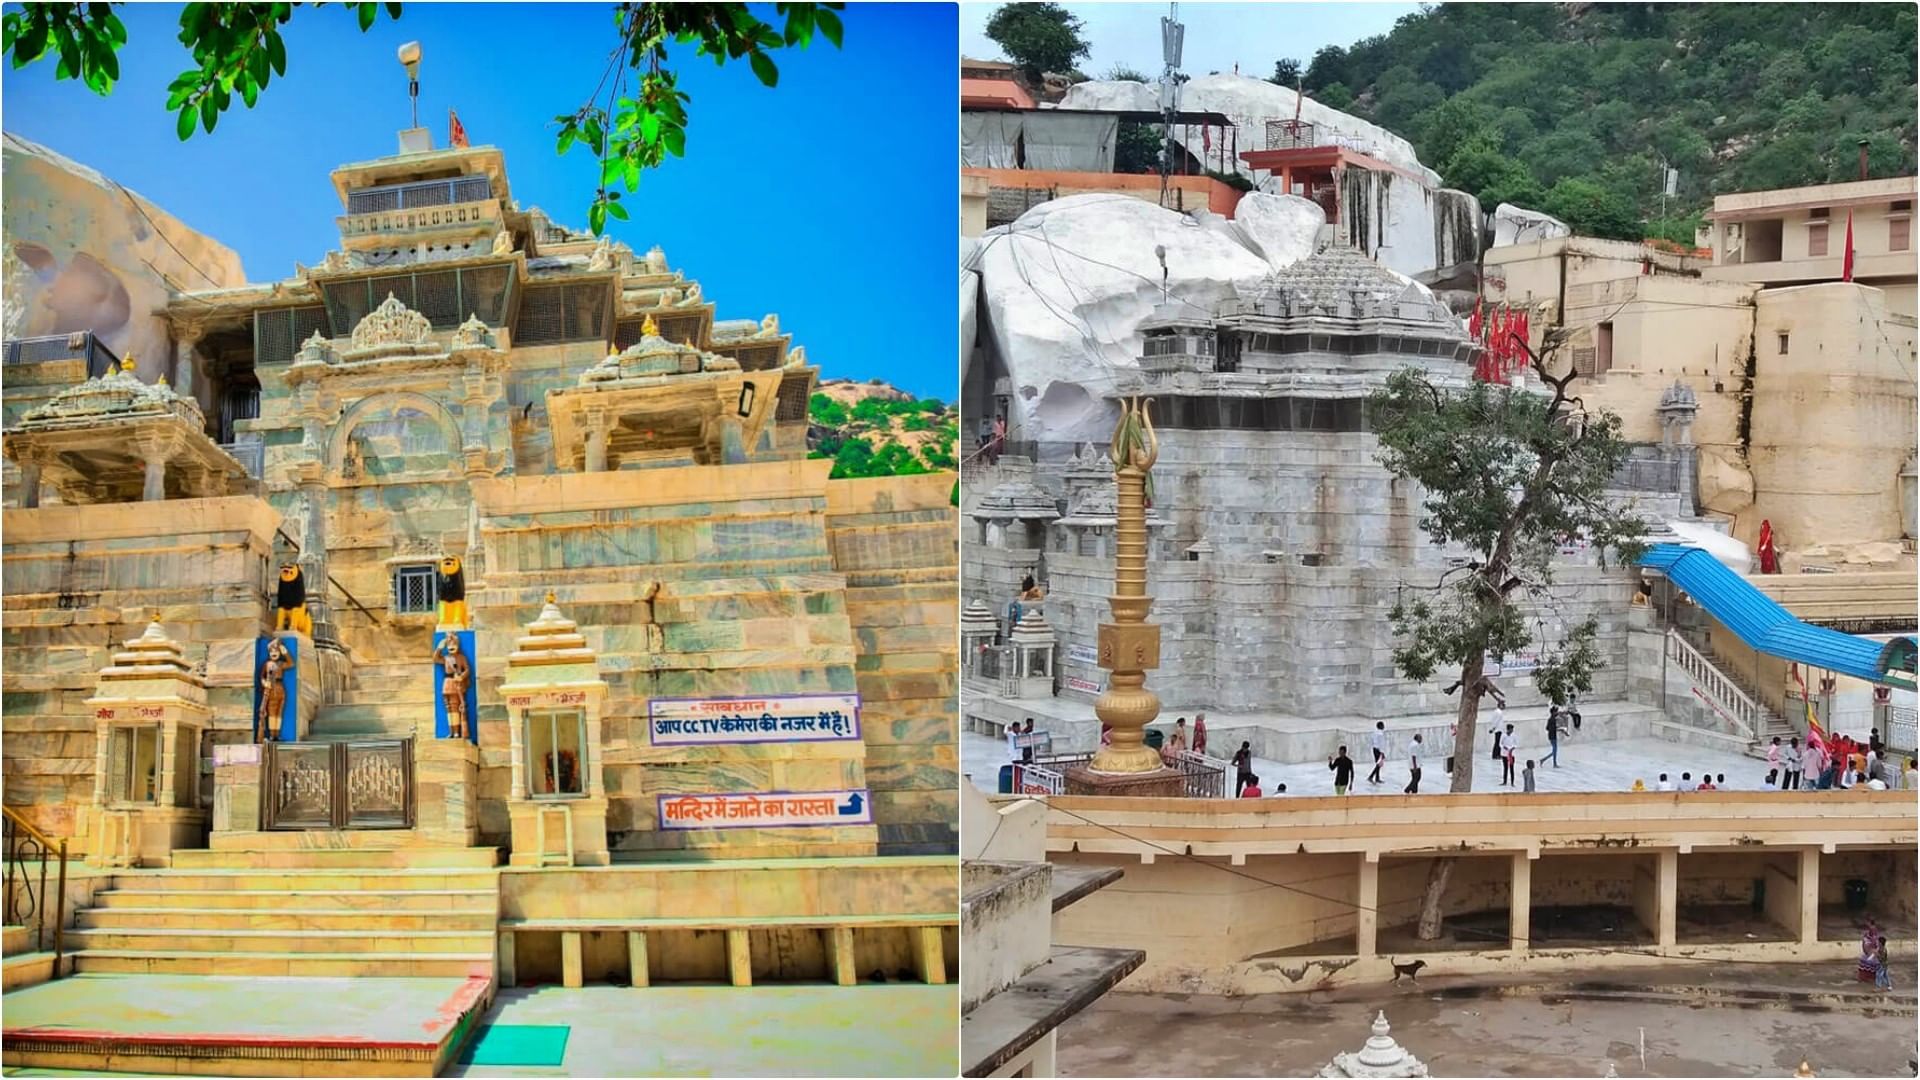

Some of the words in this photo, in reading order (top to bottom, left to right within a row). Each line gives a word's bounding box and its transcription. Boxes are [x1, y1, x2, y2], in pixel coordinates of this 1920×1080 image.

[655, 719, 681, 734] आप
[759, 713, 777, 731] की
[780, 716, 816, 731] नजर
[665, 797, 712, 821] मन्दिर
[714, 797, 727, 818] में
[728, 795, 761, 818] जाने
[763, 800, 784, 817] का
[786, 798, 835, 817] रास्ता
